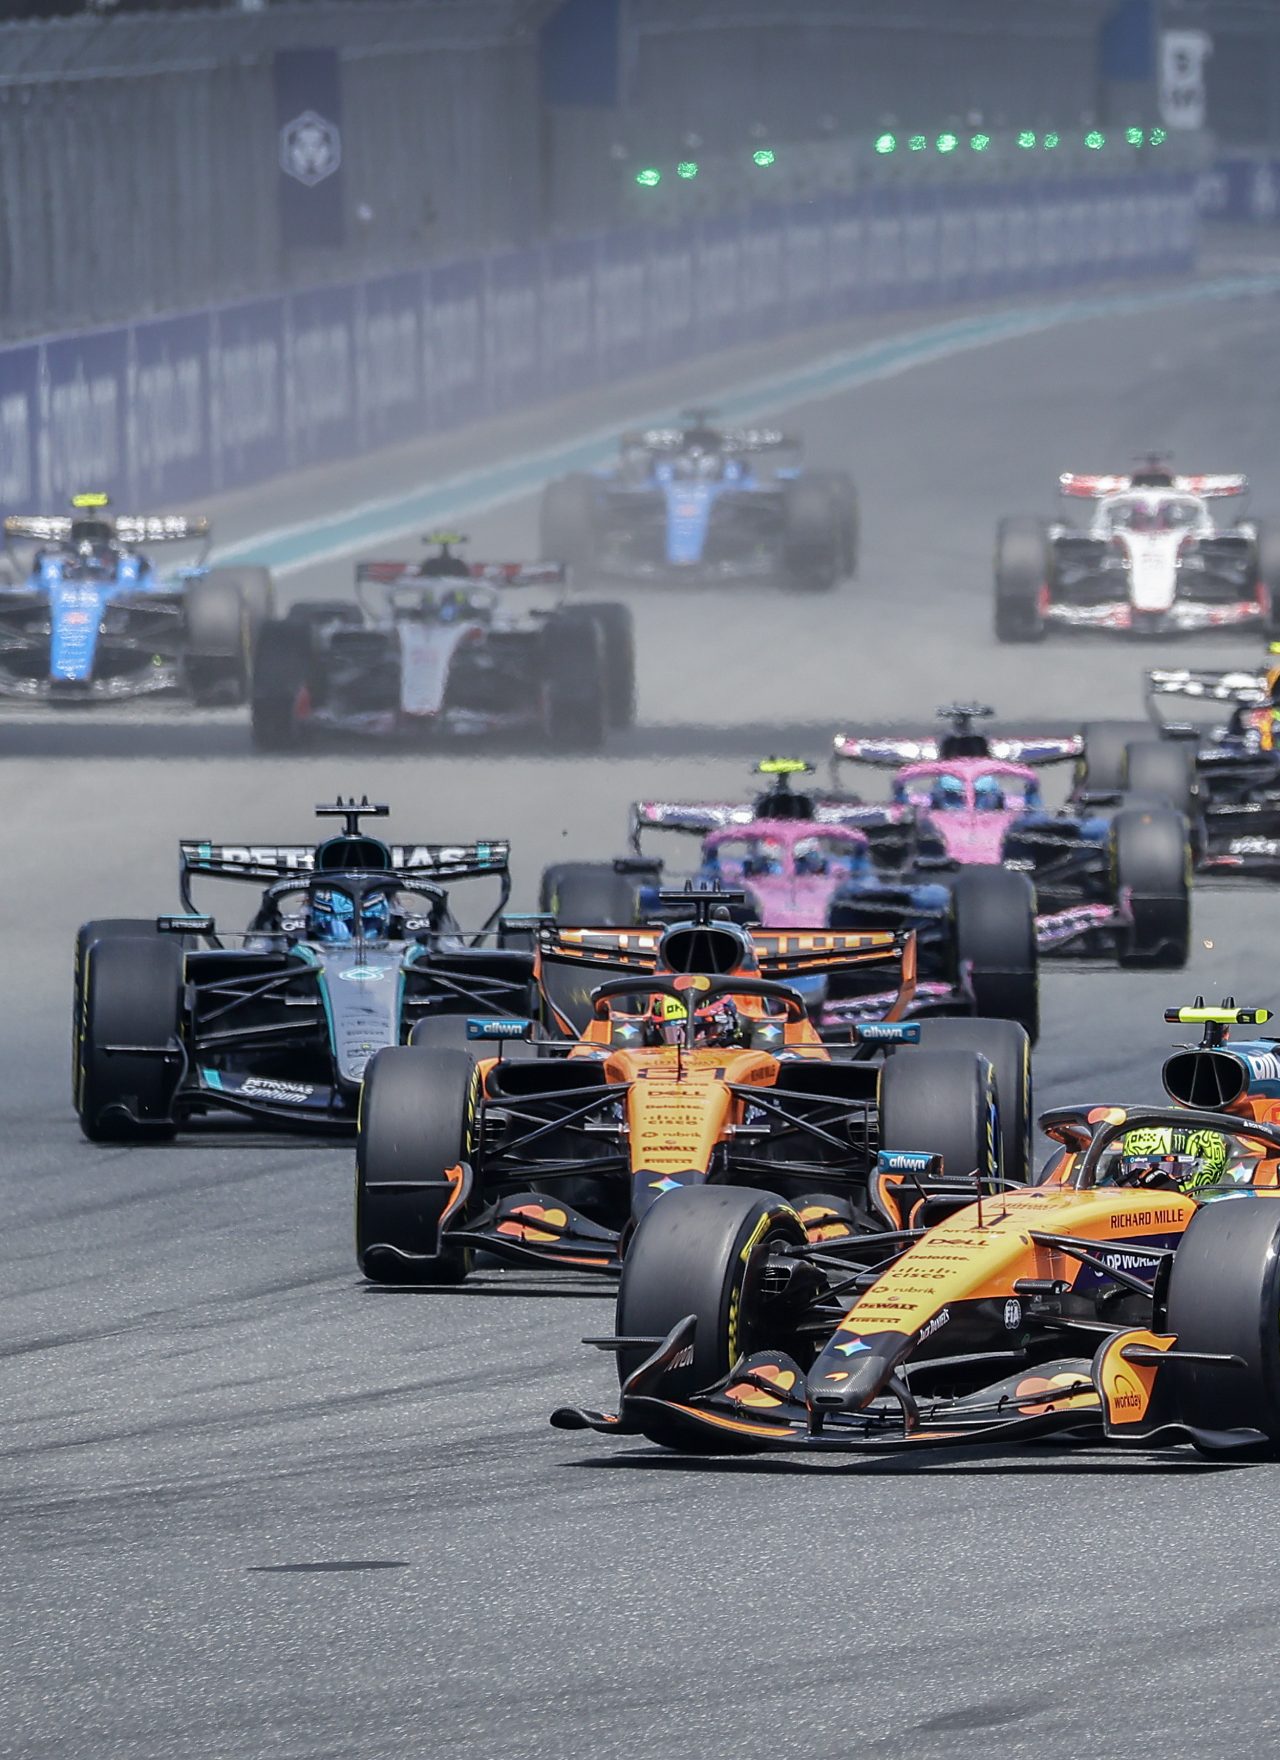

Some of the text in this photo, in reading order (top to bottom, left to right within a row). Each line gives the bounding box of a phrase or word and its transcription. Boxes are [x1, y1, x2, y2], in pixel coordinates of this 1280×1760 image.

[484, 1022, 523, 1035] allwyn
[863, 1026, 903, 1039] allwyn
[245, 1077, 314, 1095] PETRONAS
[889, 1155, 926, 1171] allwyn
[1111, 1208, 1184, 1229] RICHARD MILLE
[926, 1238, 990, 1247] DELL
[1107, 1254, 1122, 1270] DP
[893, 1286, 936, 1296] rubrik
[1114, 1391, 1142, 1410] workday
